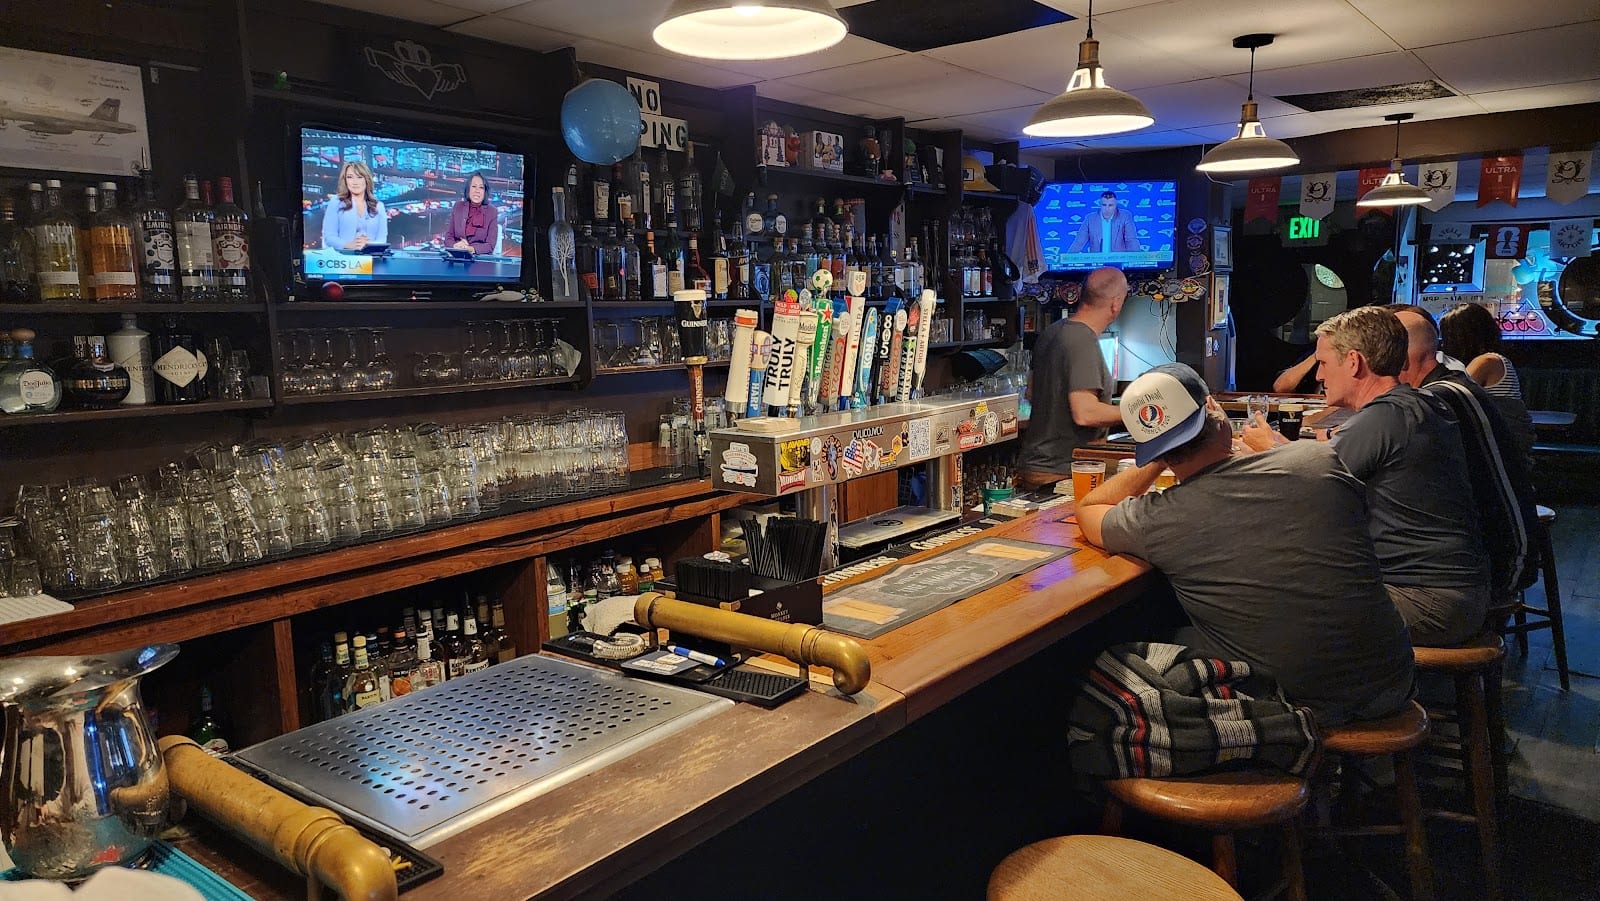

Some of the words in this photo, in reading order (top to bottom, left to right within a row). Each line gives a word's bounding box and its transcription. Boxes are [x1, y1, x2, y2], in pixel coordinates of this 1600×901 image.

[627, 83, 659, 112] NO
[640, 119, 688, 148] PING
[1362, 178, 1385, 186] ULTR
[1485, 166, 1517, 174] ULTRA
[146, 221, 171, 229] SMIRN
[1557, 224, 1585, 236] STELLA
[326, 259, 347, 269] CBS
[348, 260, 363, 269] LA
[814, 325, 829, 374] Heineken
[880, 314, 893, 356] 805
[765, 334, 782, 388] TRULY
[778, 338, 796, 391] TRULY
[863, 336, 876, 368] KONA
[695, 375, 704, 413] GUINNESS
[750, 382, 760, 411] HARP
[1144, 387, 1164, 402] Dead
[821, 555, 899, 587] UINNESS
